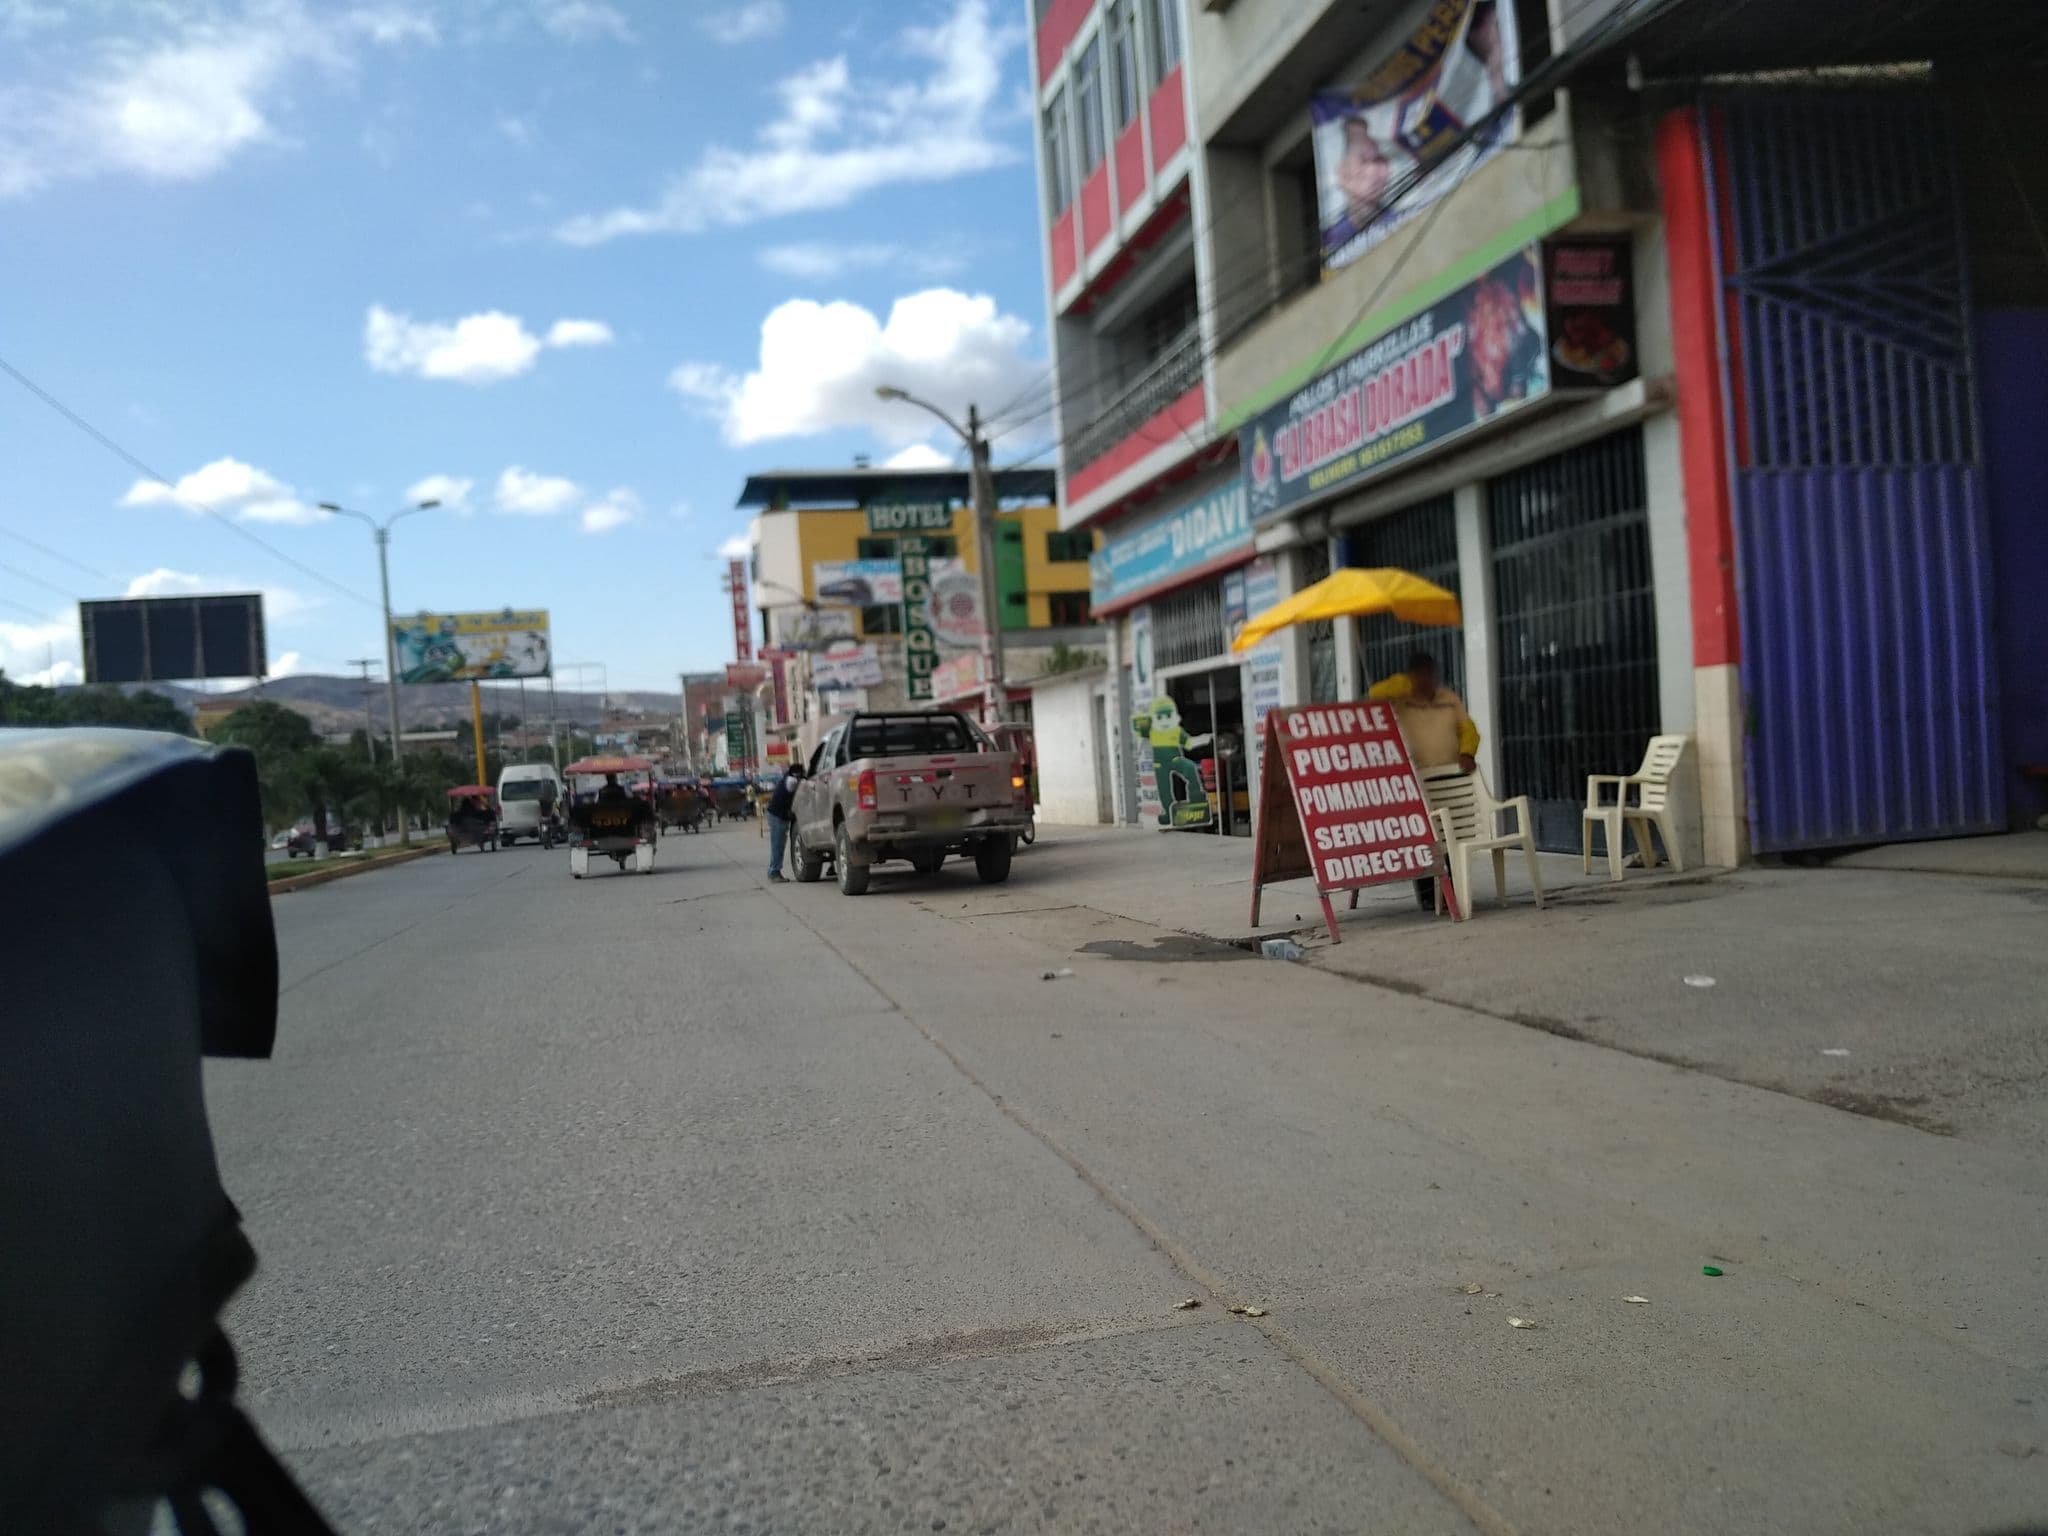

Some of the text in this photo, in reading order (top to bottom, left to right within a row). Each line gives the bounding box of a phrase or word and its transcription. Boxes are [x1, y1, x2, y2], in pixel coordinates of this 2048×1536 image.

[1302, 387, 1362, 467] BRASA
[873, 503, 948, 529] HOTEL
[1287, 705, 1389, 740] CHIPLE
[1292, 739, 1403, 777] PUCARA
[1299, 773, 1421, 816] POMAHUACA
[1313, 813, 1427, 851] SERVICIO
